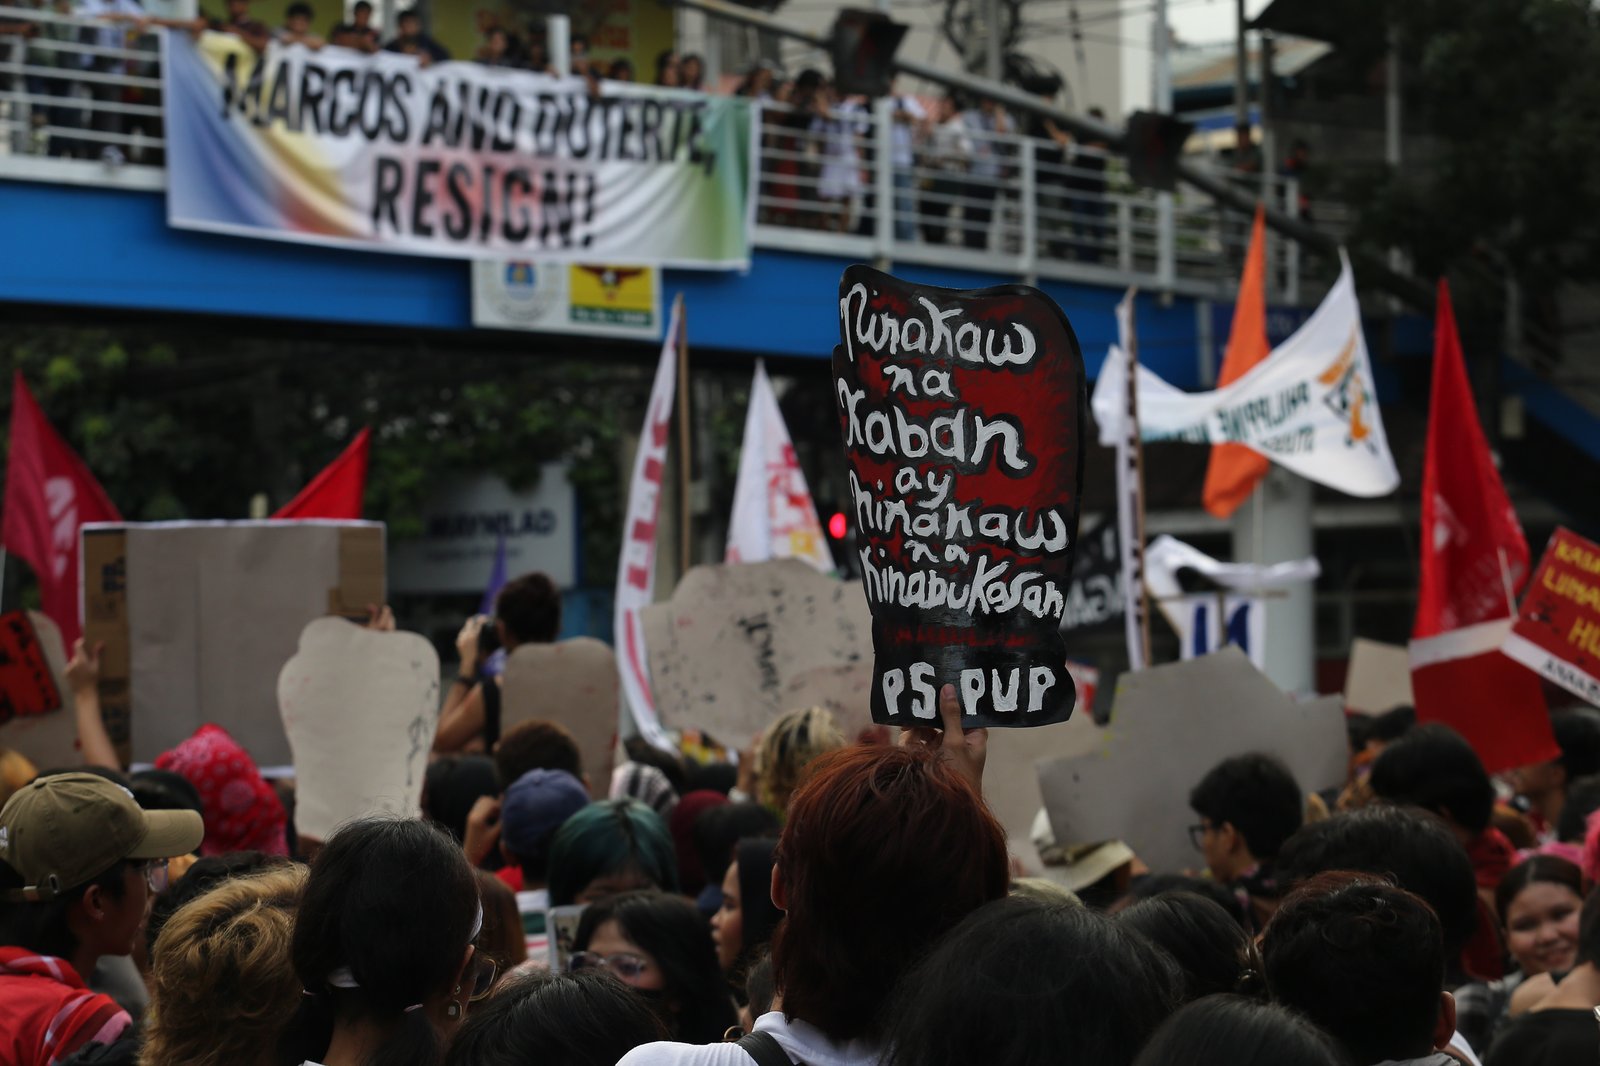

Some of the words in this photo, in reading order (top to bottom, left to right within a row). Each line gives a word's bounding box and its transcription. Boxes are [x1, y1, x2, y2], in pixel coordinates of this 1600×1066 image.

[222, 54, 413, 142] MARCOS
[423, 77, 520, 151] AND
[373, 157, 594, 249] RESIGN!
[883, 365, 955, 398] na
[895, 466, 951, 508] ay
[904, 539, 970, 564] na
[882, 662, 937, 719] PS
[960, 666, 1056, 716] PUP
